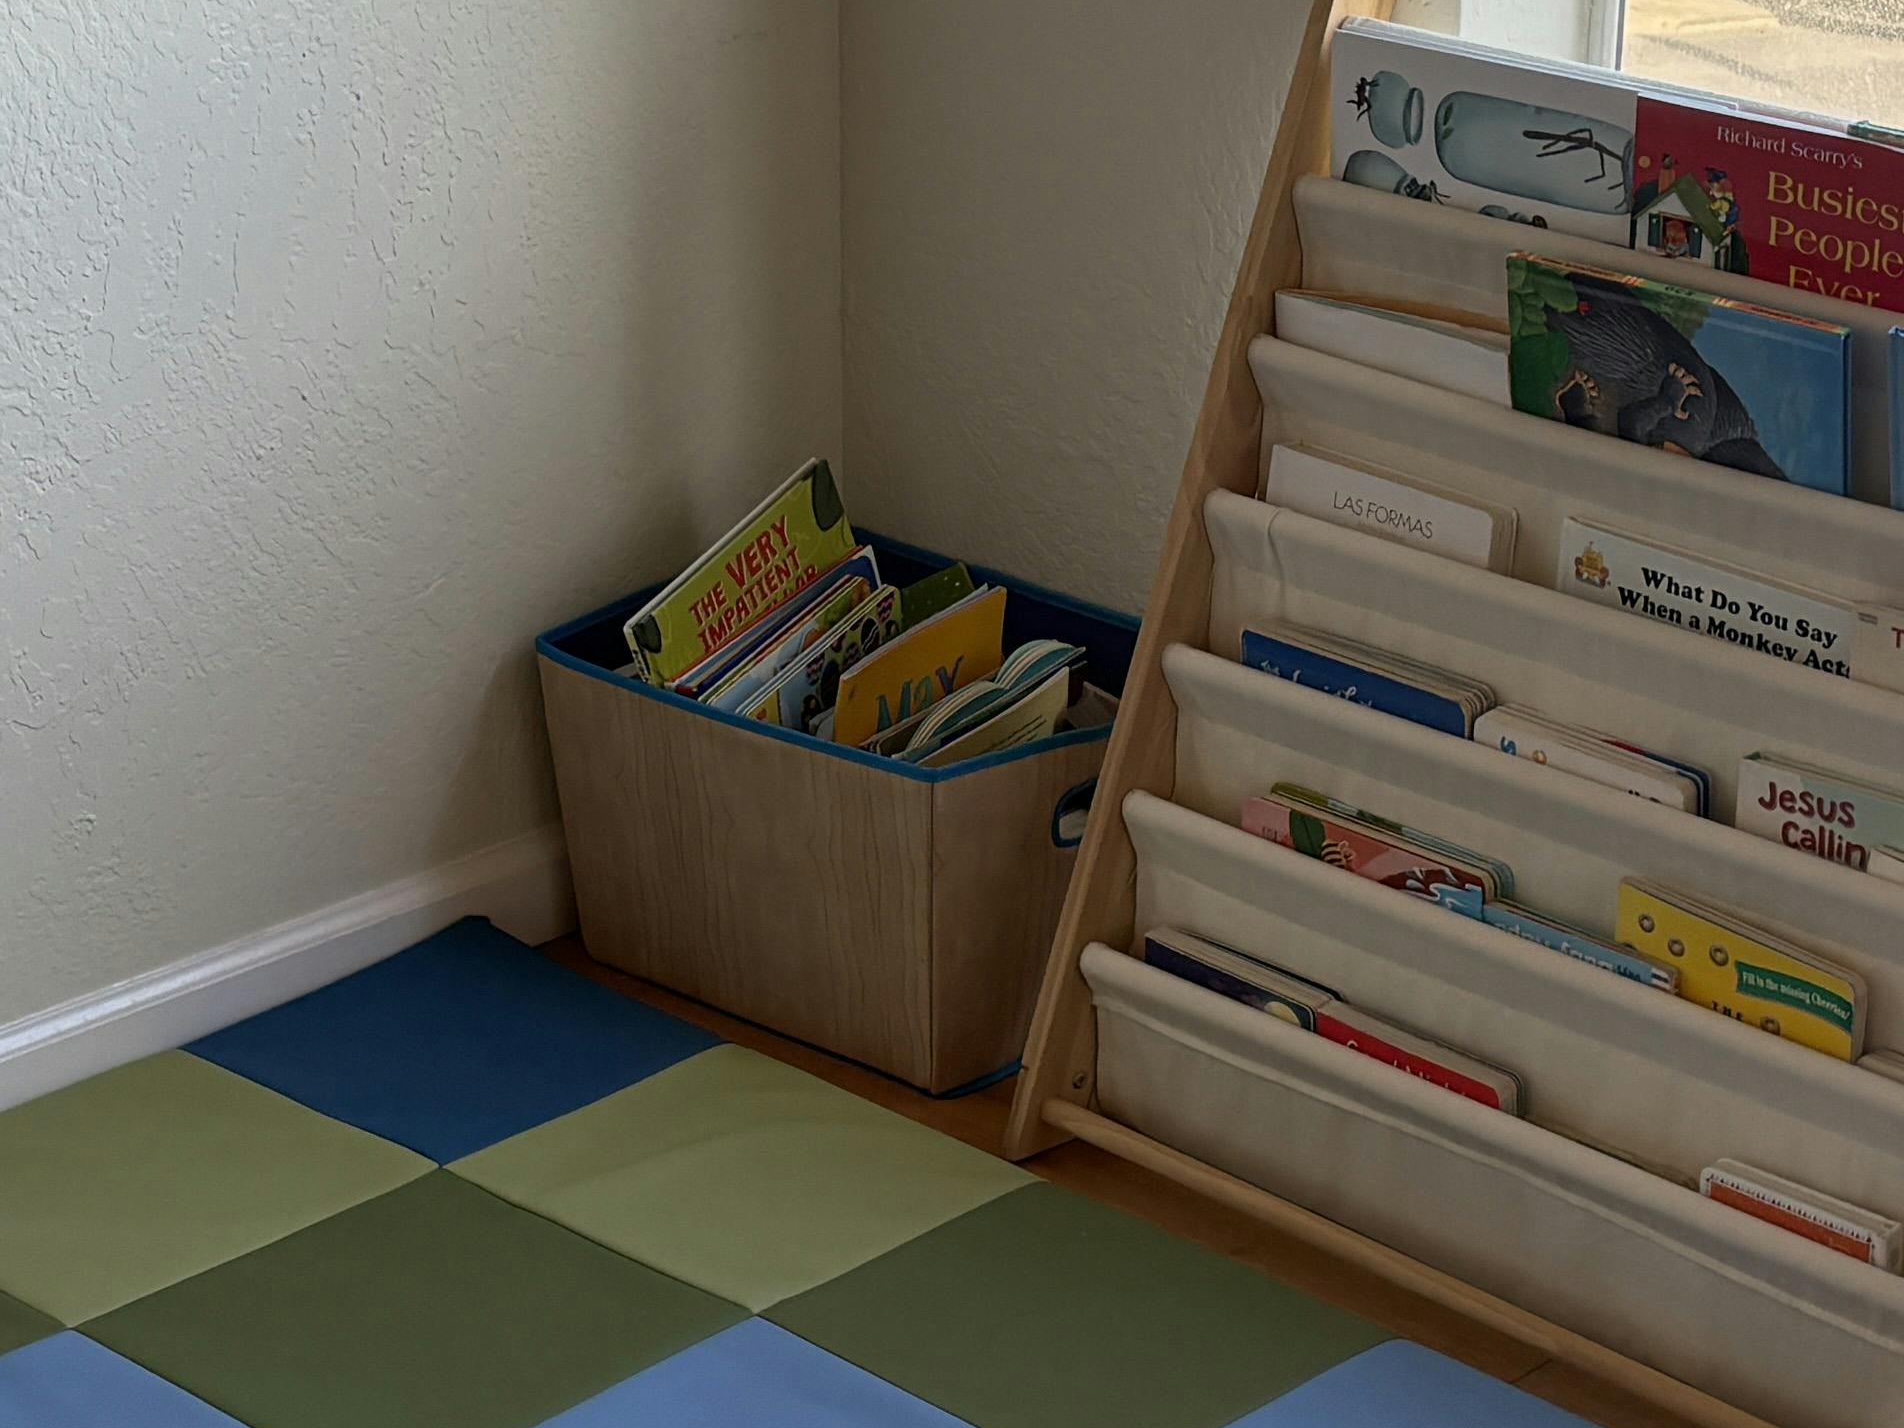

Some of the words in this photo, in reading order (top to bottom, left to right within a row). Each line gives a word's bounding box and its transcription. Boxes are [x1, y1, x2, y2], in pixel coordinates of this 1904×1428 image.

[1716, 125, 1786, 155] Richard
[1792, 137, 1864, 170] Scarry's
[1769, 215, 1904, 279] People
[1788, 265, 1881, 309] Ever
[1333, 489, 1364, 518] LAS
[1366, 501, 1434, 541] FORMAS
[688, 581, 728, 621] THE
[725, 515, 789, 590] VERY
[697, 548, 804, 654] IMPATIENT
[1617, 584, 1684, 627] When
[1688, 613, 1702, 631] a
[1705, 617, 1799, 663] Monkey
[1641, 566, 1705, 605] What
[1710, 587, 1741, 617] Do
[1747, 601, 1790, 633] You
[1795, 617, 1839, 650] Say
[1781, 820, 1867, 872] Callin
